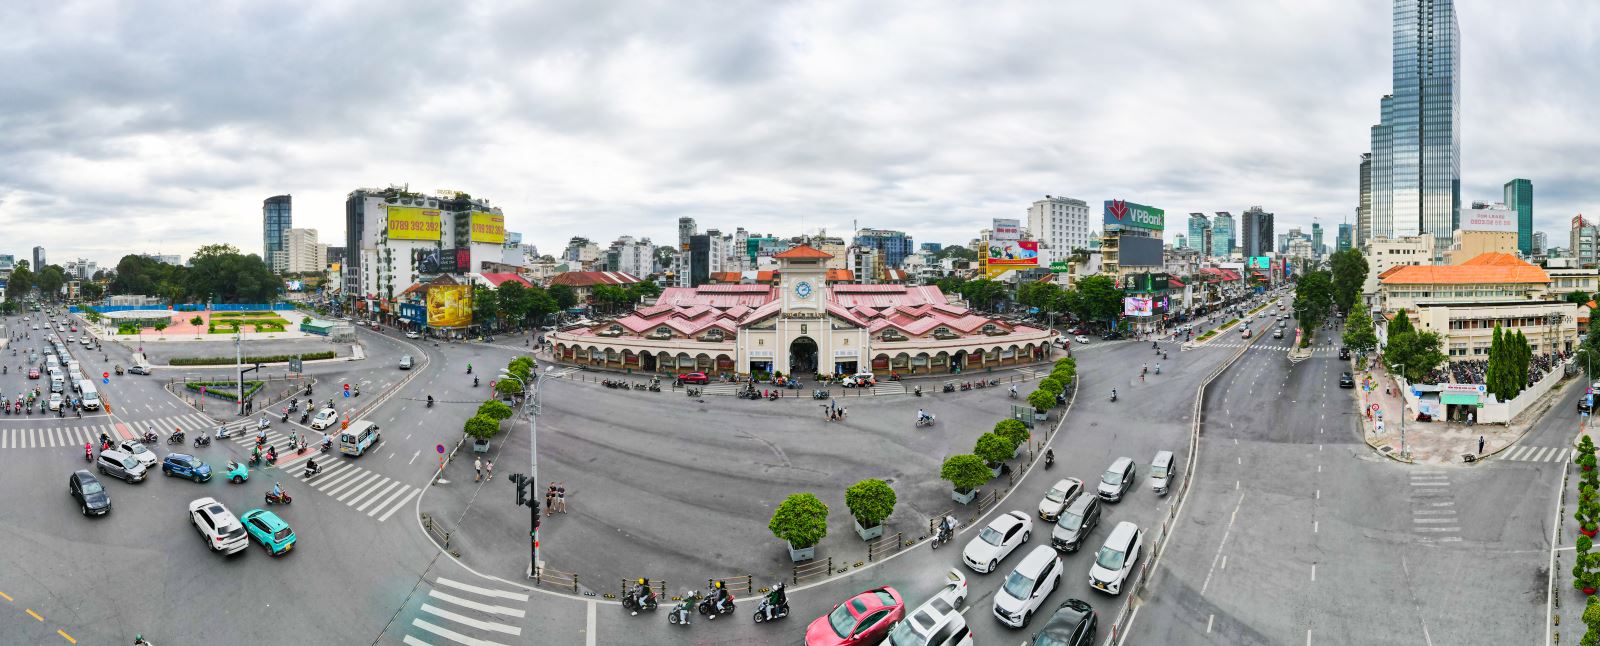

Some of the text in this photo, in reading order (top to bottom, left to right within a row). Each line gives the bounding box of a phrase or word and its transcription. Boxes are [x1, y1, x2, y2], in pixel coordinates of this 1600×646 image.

[1130, 208, 1163, 225] VPBank
[390, 220, 439, 232] 0789 392 392
